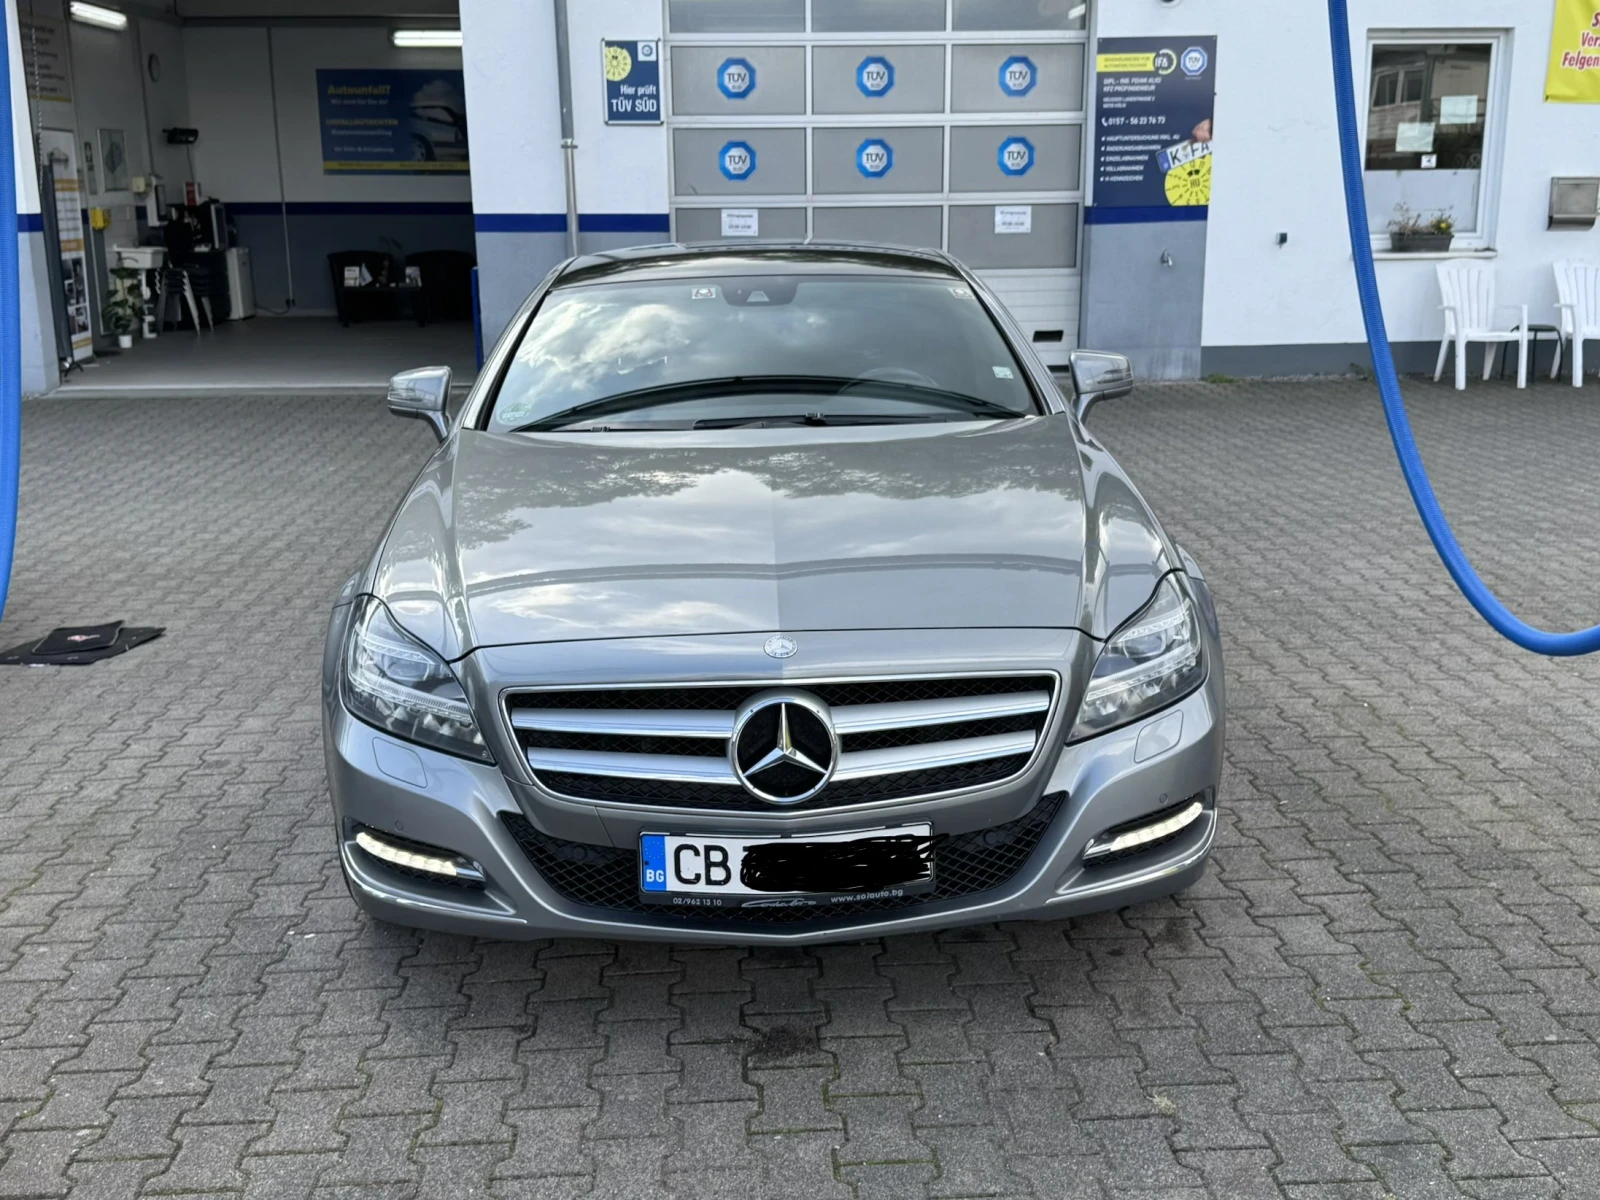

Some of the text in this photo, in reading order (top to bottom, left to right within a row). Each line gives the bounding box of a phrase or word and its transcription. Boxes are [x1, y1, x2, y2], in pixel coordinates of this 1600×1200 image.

[1592, 12, 1600, 27] S
[1562, 50, 1600, 70] Felgen
[328, 84, 391, 95] Autounfall?
[620, 84, 657, 97] Hier prüft
[611, 97, 657, 112] TÜV SÜD
[1108, 117, 1125, 125] 0157
[1130, 116, 1139, 125] 56
[674, 844, 732, 886] CB
[646, 869, 665, 882] BG
[672, 897, 701, 905] 02/962
[702, 898, 711, 906] 13
